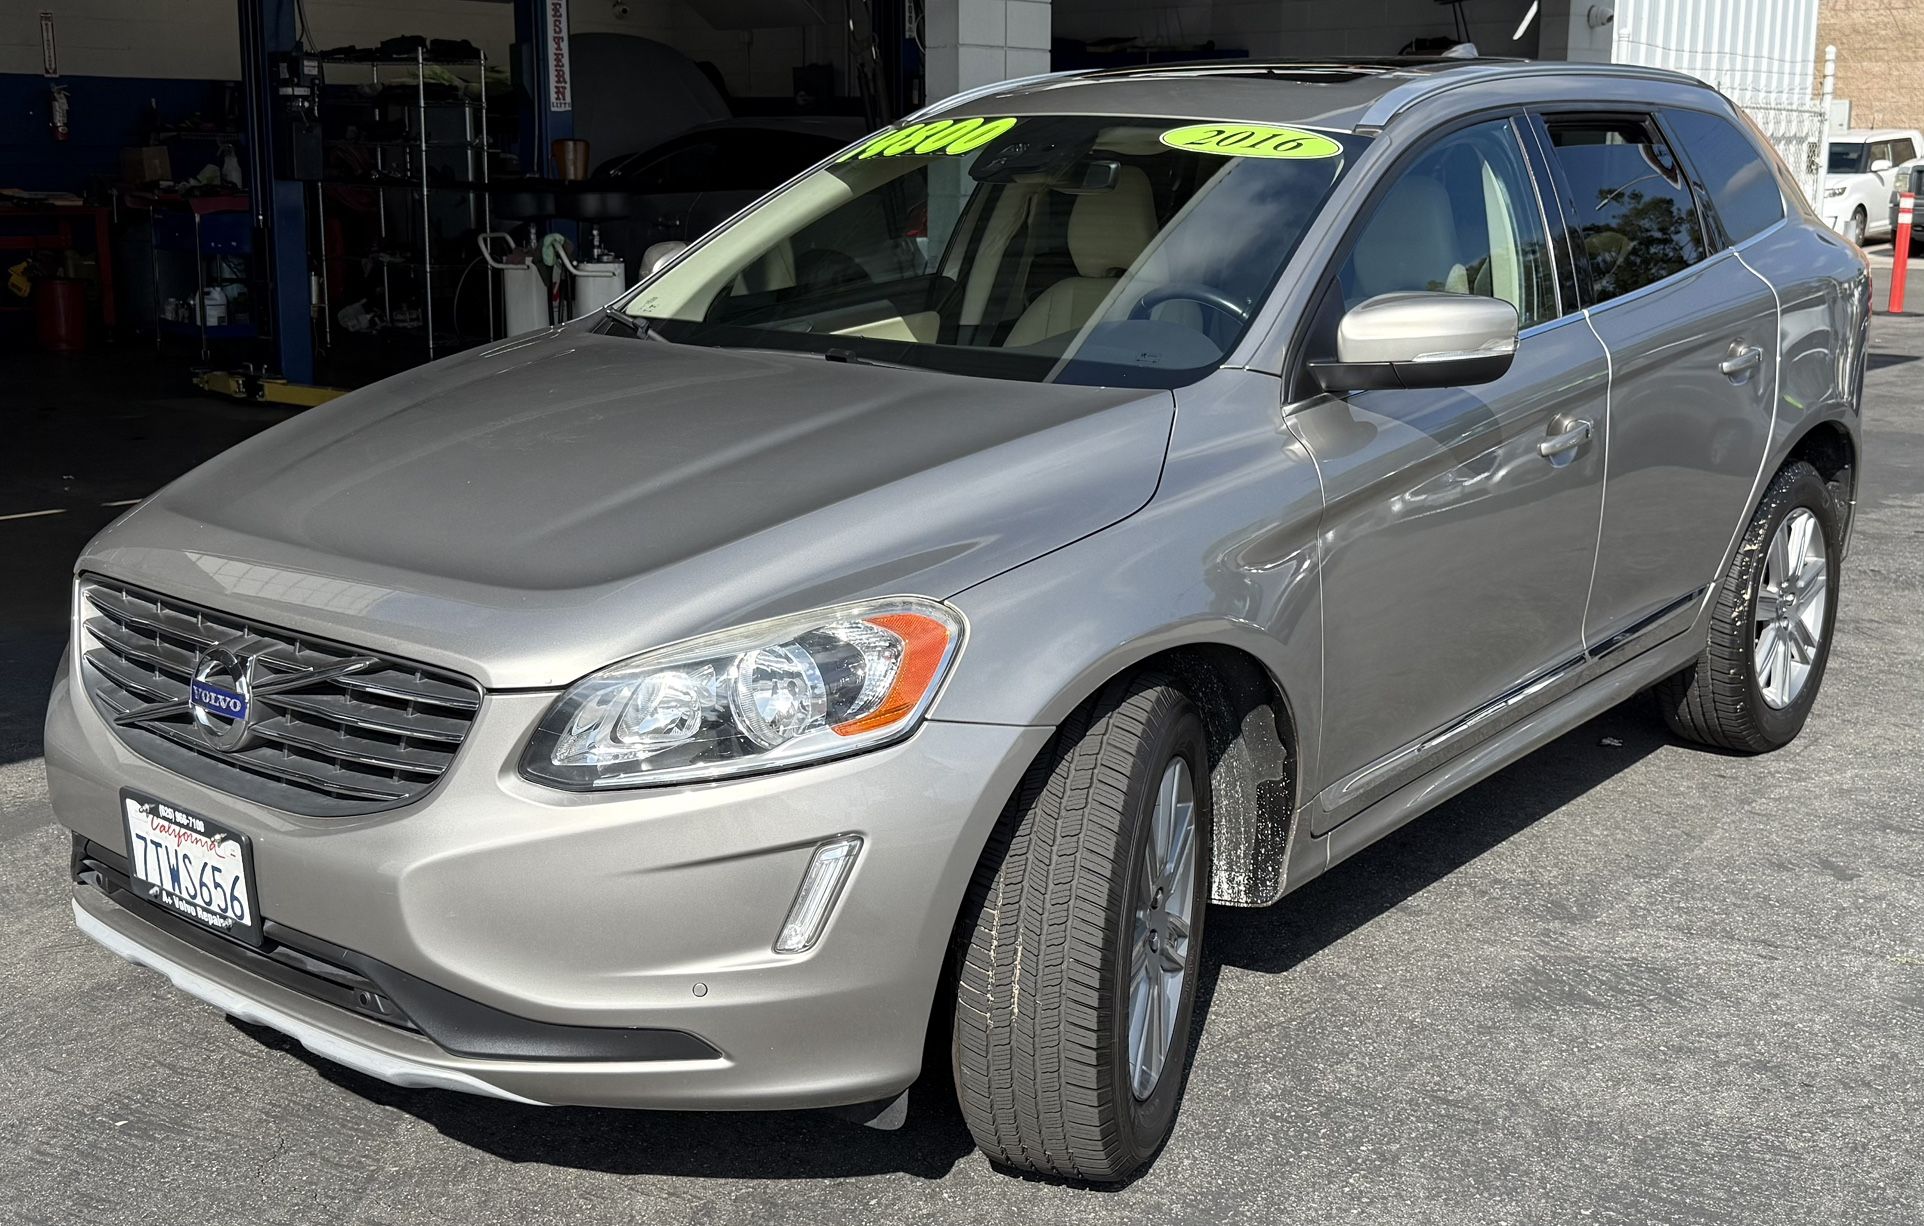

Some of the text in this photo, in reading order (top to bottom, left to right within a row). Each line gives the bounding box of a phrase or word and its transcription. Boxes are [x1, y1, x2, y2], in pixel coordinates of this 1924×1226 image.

[552, 0, 567, 101] ESTERN
[1184, 129, 1316, 152] 2016
[193, 685, 242, 712] VOLVO
[135, 833, 245, 921] 7TWS656
[173, 895, 197, 916] Volvo
